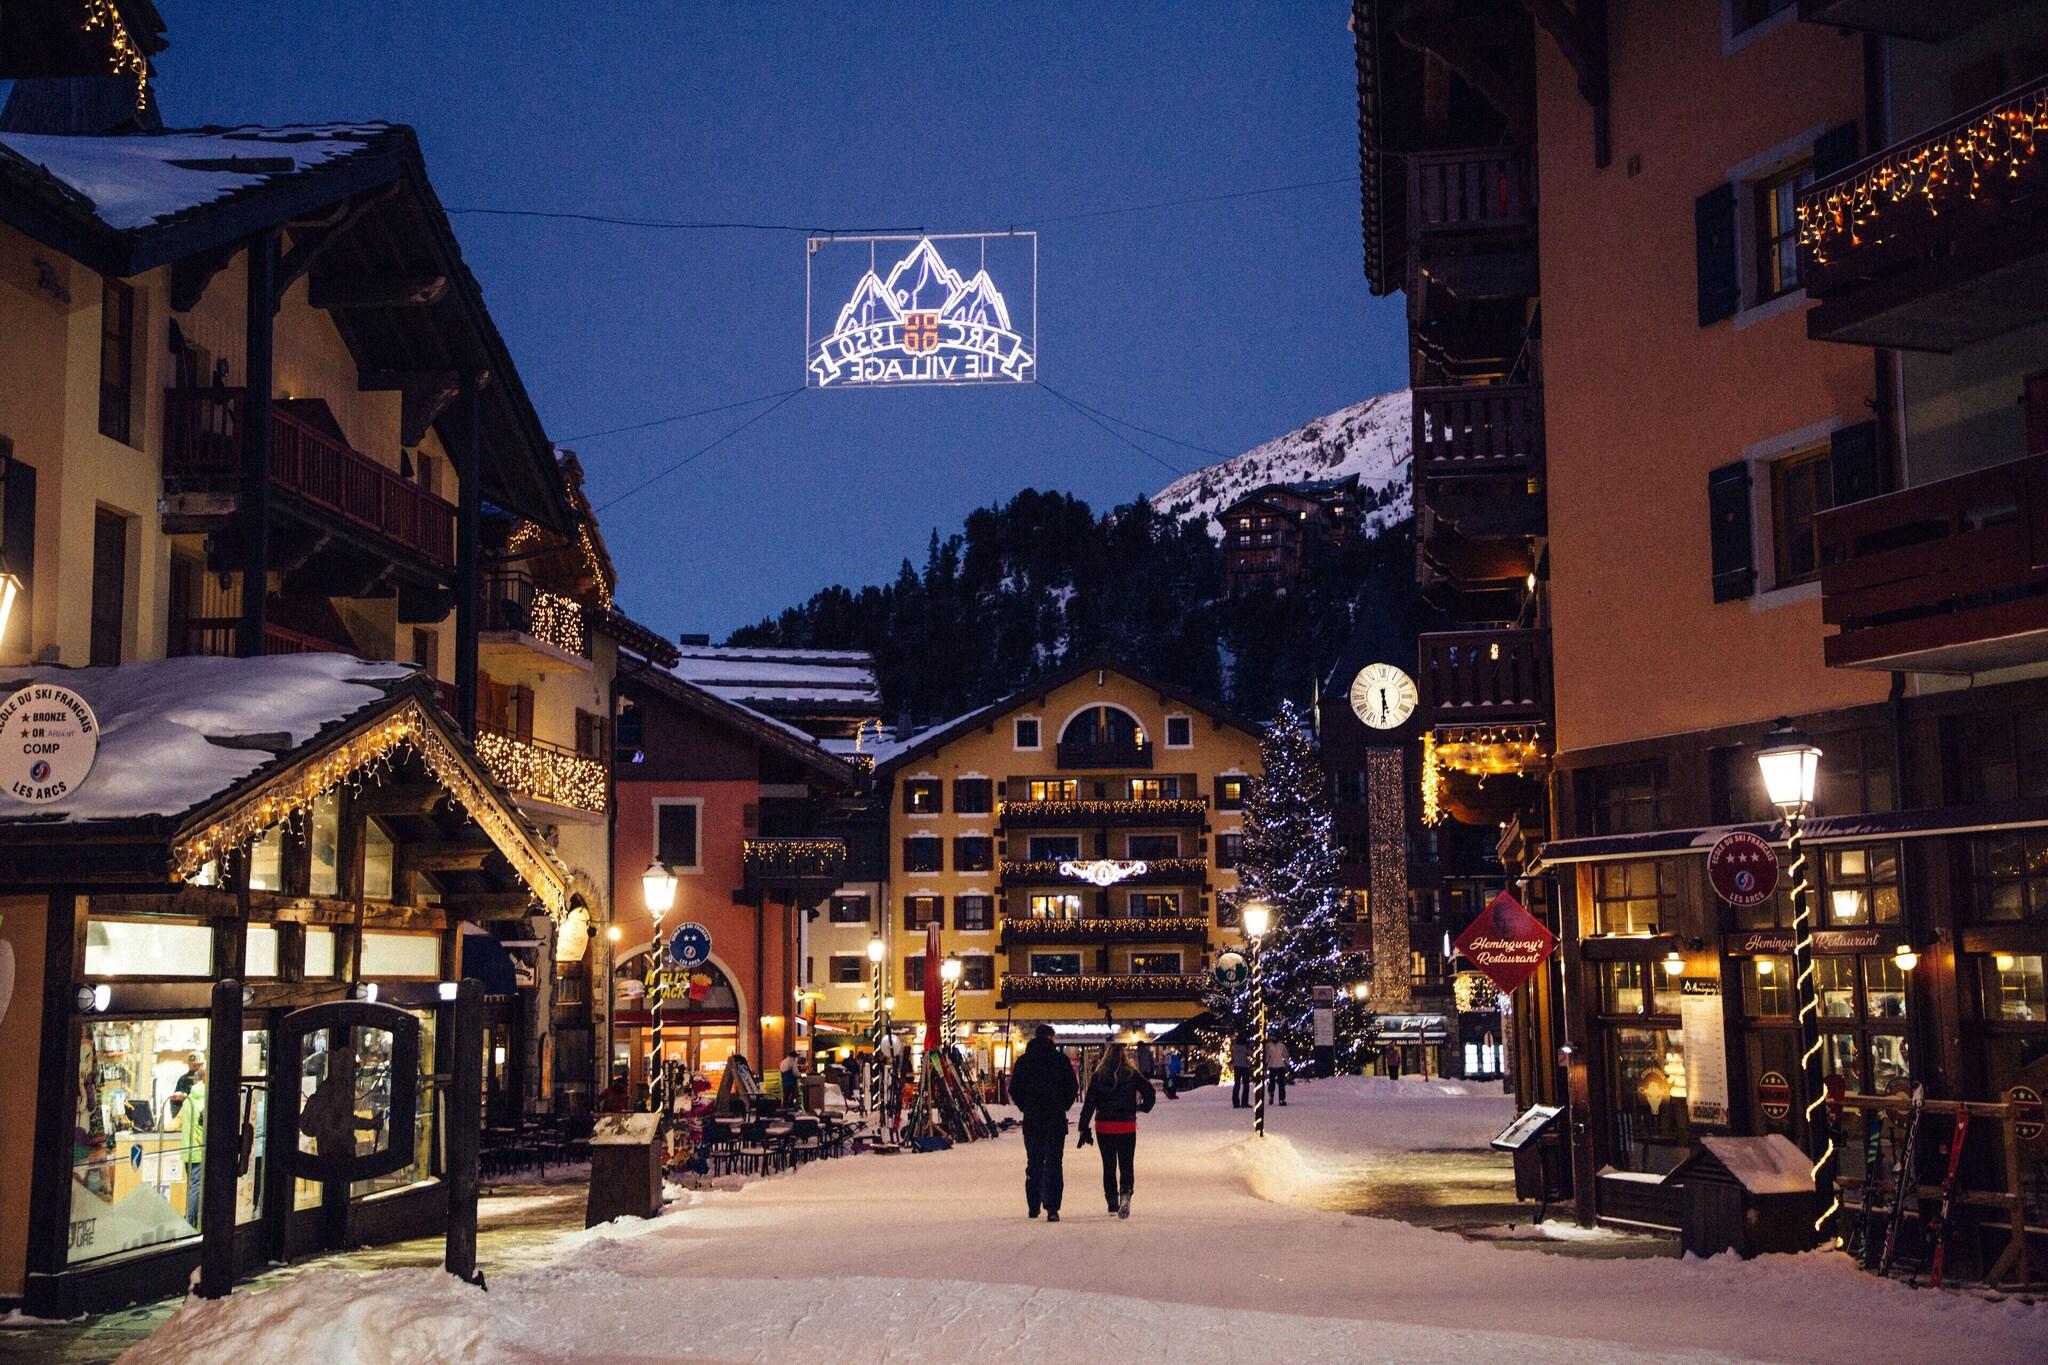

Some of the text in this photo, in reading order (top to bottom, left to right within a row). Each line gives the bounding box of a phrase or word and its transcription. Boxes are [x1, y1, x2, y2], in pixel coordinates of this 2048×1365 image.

[0, 688, 92, 735] COLE DU SKI FRANCAIS
[32, 712, 67, 722] BRONZE
[32, 728, 45, 738] OR
[23, 743, 60, 754] COMP
[12, 781, 67, 799] LES ARCS
[1711, 834, 1775, 865] ECOLE DU SKI FRANCAIS
[1730, 891, 1765, 904] LES ARCS
[1469, 937, 1543, 952] Hemingway's
[1816, 933, 1880, 949] Restaurant
[1476, 952, 1540, 965] Restaurant
[646, 986, 687, 1000] SACK
[78, 1218, 96, 1232] PICT
[76, 1232, 94, 1247] URE
